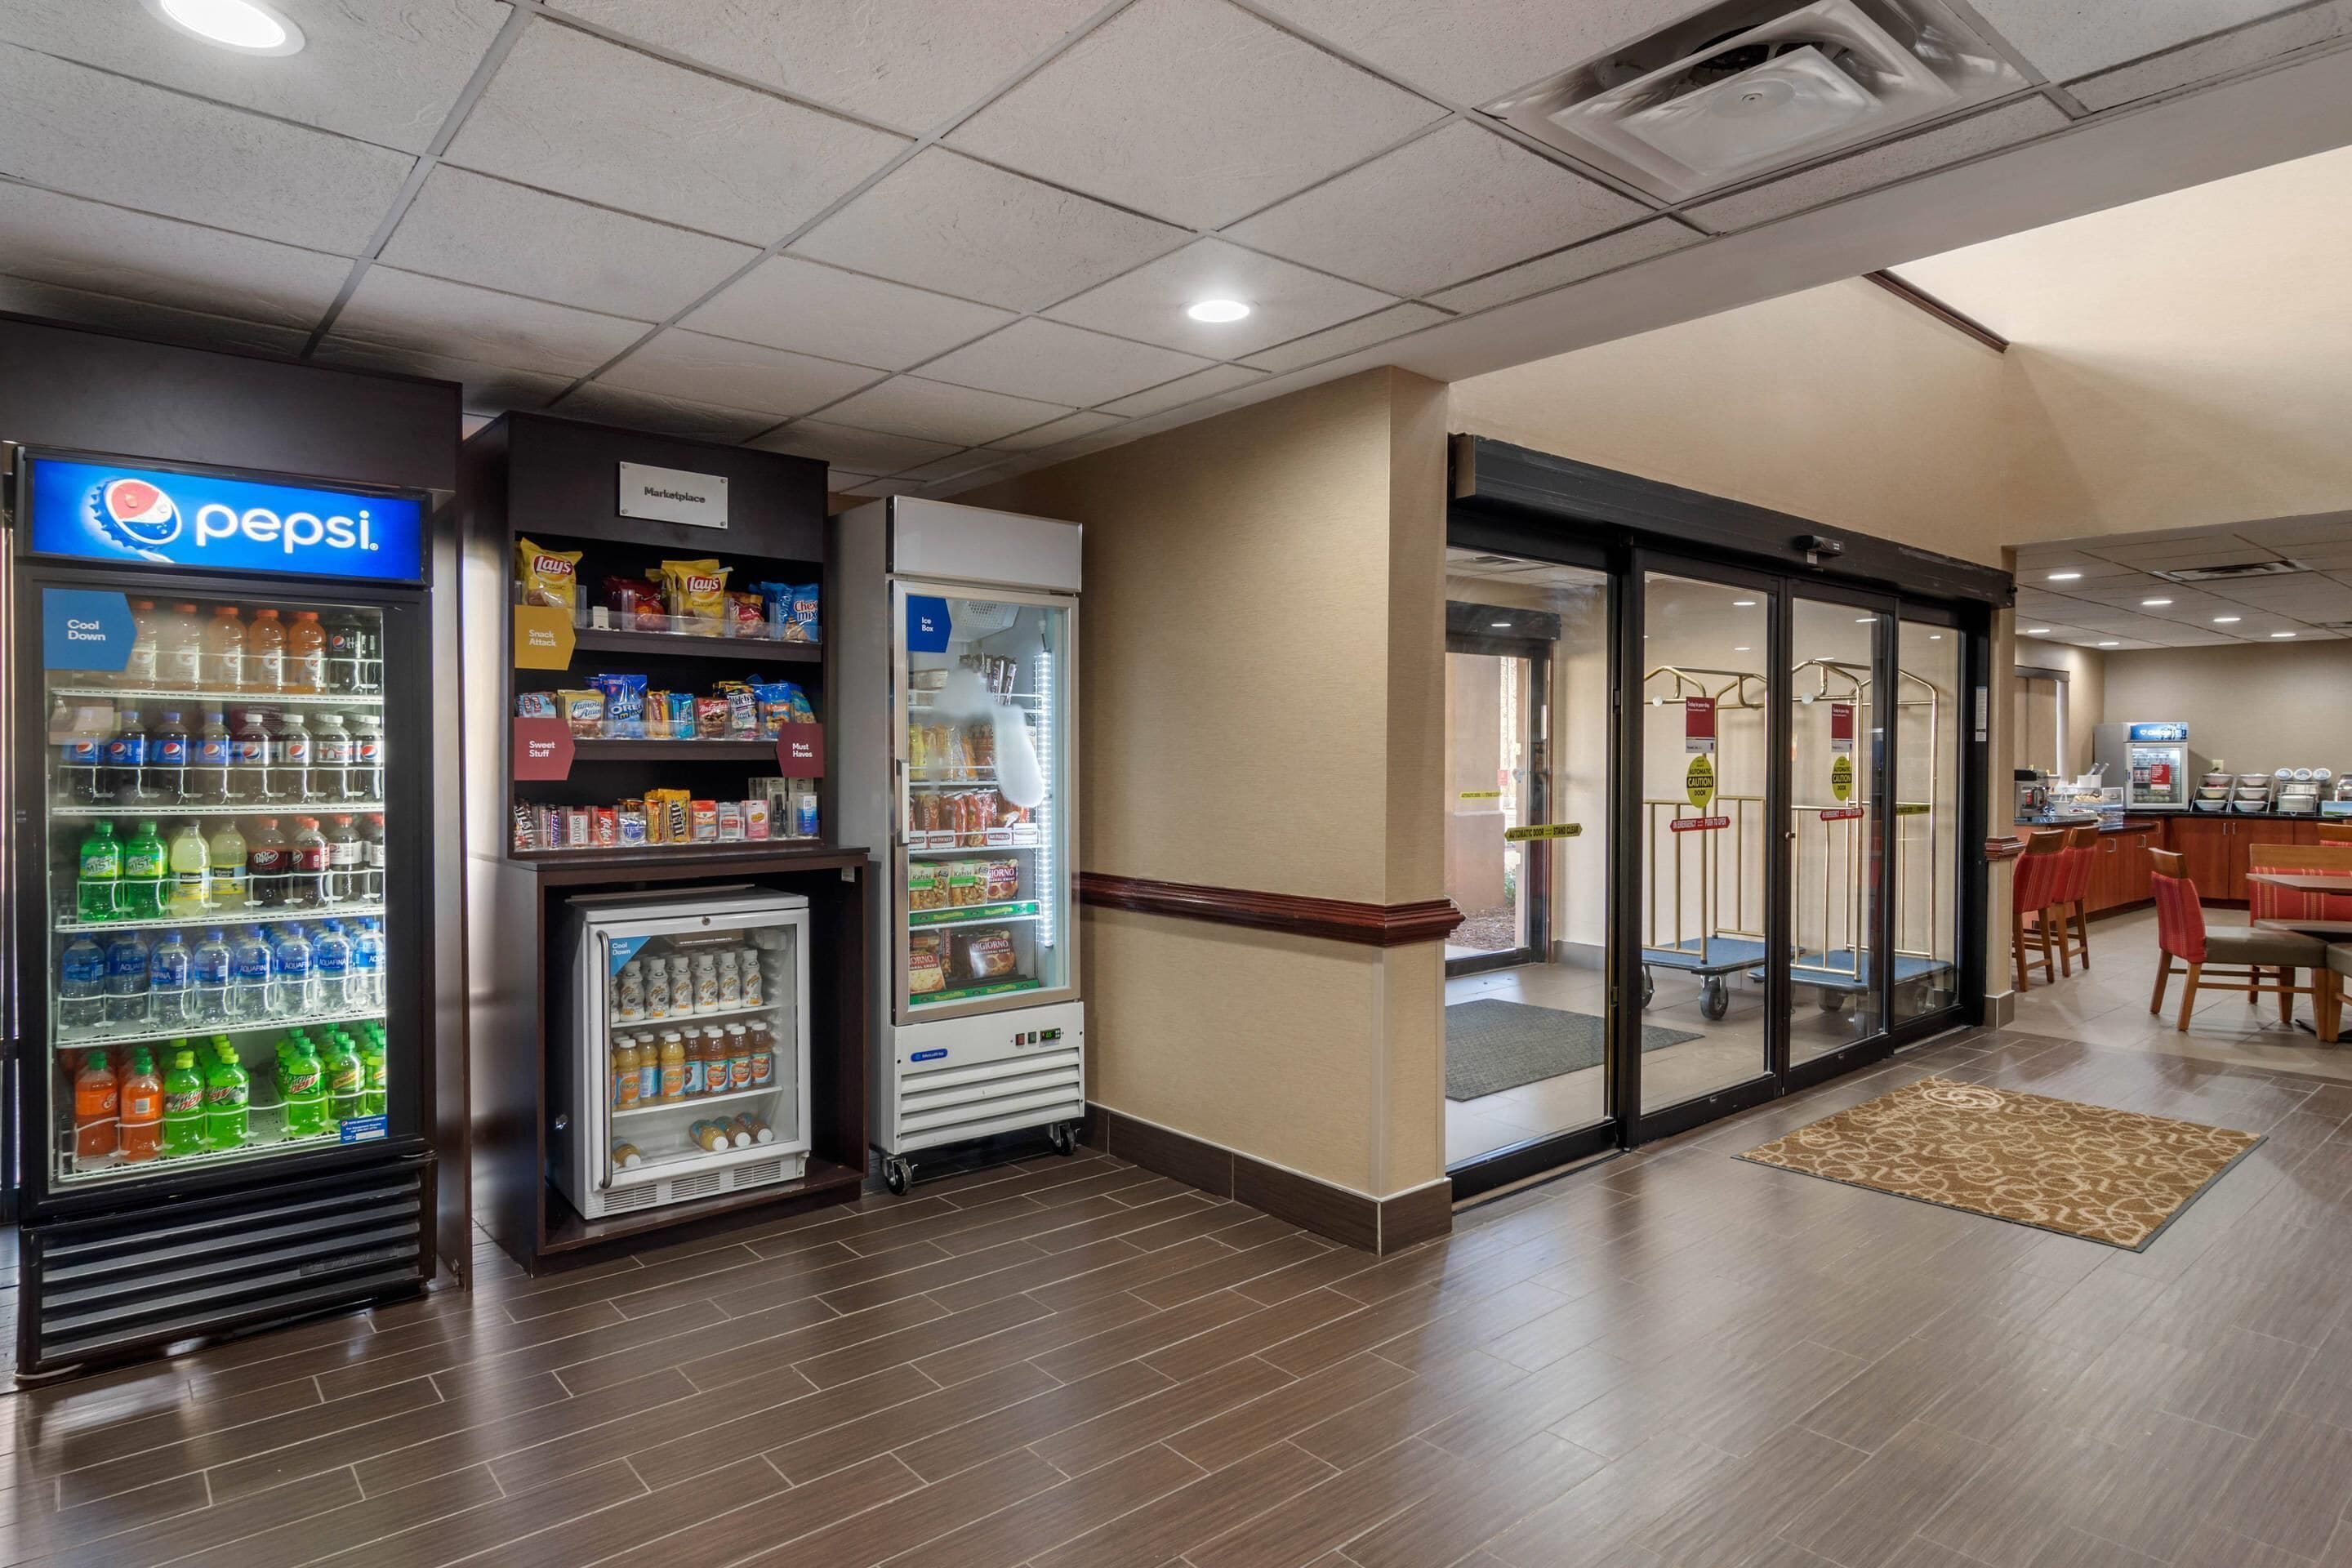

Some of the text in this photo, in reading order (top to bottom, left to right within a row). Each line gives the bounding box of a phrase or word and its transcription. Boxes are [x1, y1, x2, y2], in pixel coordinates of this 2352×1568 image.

[644, 486, 706, 503] Marketplace
[196, 503, 371, 555] pepsi
[794, 600, 817, 612] Chex
[67, 619, 100, 630] Cool
[921, 617, 932, 625] Ice
[67, 630, 106, 641] Down
[528, 629, 555, 639] Snack
[528, 638, 557, 647] Attack
[729, 695, 755, 706] Welch's
[528, 740, 556, 749] Sweet
[528, 749, 550, 758] Stuff
[1687, 777, 1713, 787] CAUTION
[1833, 774, 1851, 782] CAUTION
[1509, 826, 1579, 839] AUTOMATIC DOOR STAND CLEAR
[254, 852, 277, 864] Pepper
[87, 858, 113, 873] MIST
[127, 858, 151, 872] MIST
